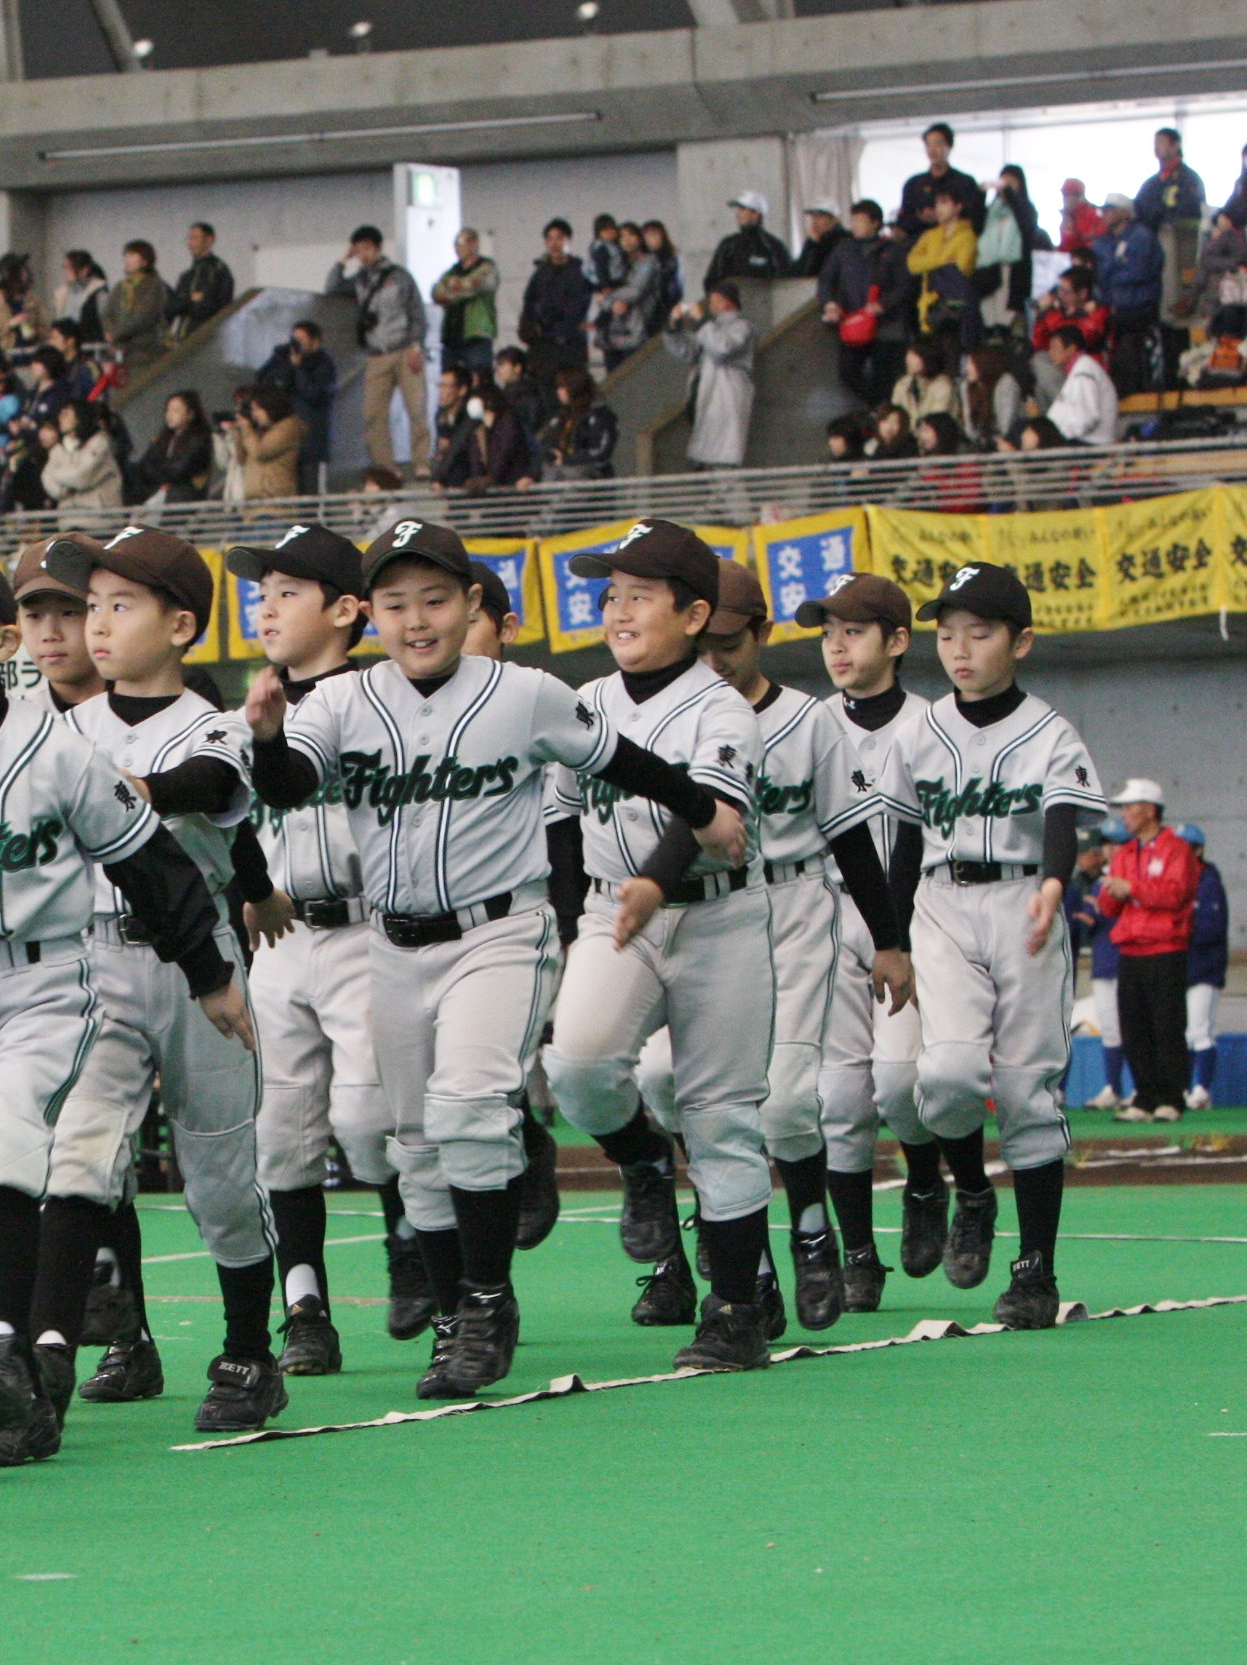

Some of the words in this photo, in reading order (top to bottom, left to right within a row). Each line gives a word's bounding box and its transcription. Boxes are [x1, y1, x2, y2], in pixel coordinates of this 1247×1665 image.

[1116, 536, 1213, 583] 交通安全
[717, 745, 737, 769] 東
[339, 748, 519, 827] Fighters
[1074, 765, 1091, 788] 東
[113, 780, 137, 813] 東
[755, 776, 815, 815] ters
[914, 776, 1044, 841] Fighters
[218, 1361, 250, 1376] ZETT
